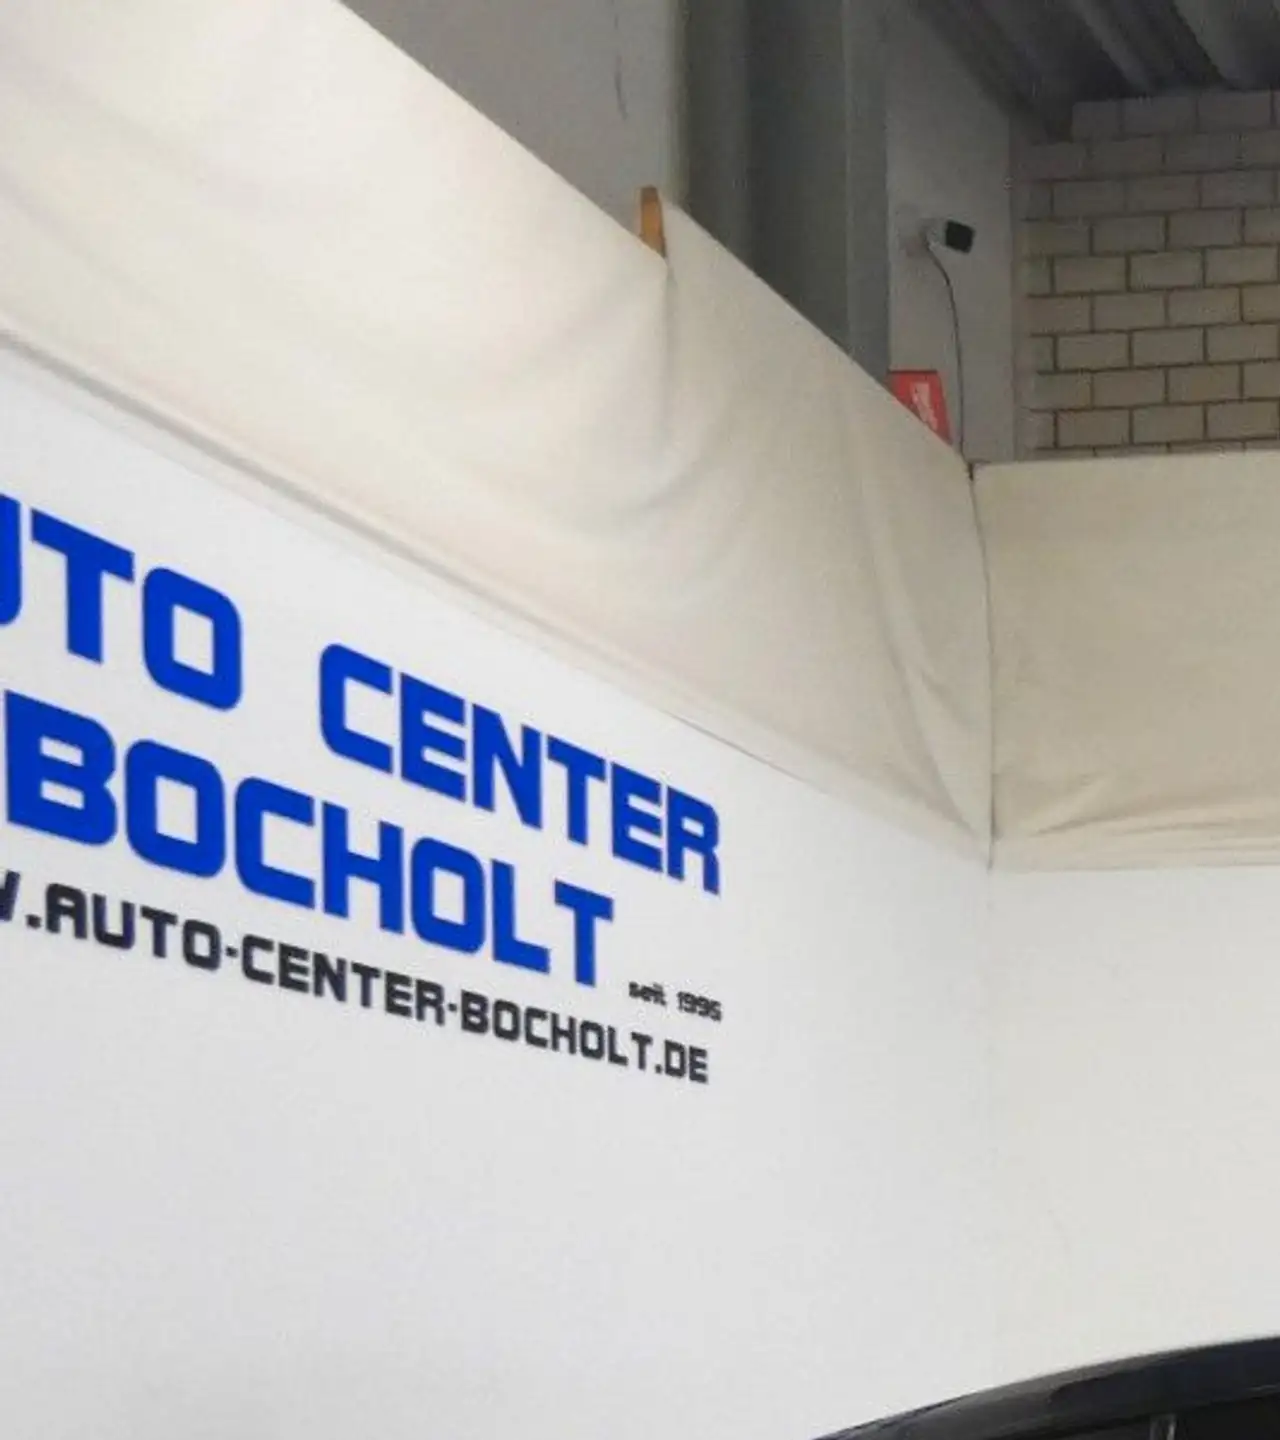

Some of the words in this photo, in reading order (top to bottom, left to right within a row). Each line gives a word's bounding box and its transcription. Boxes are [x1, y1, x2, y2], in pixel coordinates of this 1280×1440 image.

[0, 492, 243, 712] TO
[318, 643, 720, 896] CENTER
[4, 689, 614, 988] BOCHOLT
